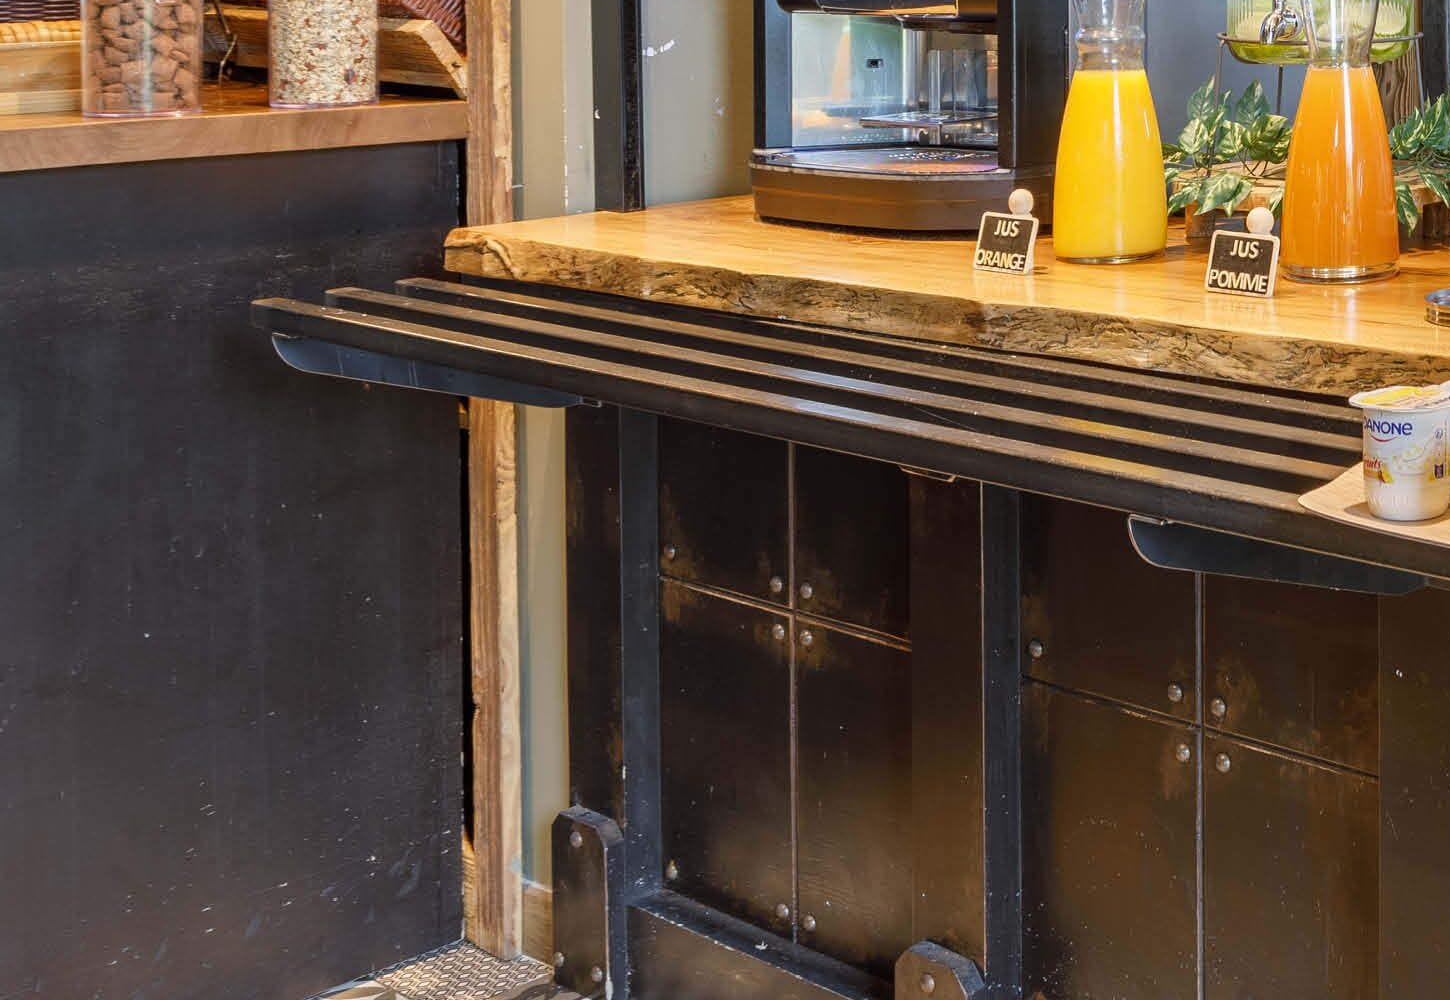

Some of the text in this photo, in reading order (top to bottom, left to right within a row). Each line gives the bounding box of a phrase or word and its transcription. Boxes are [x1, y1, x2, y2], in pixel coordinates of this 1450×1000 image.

[994, 219, 1020, 238] JUS
[976, 248, 1026, 270] ORANGE
[1229, 239, 1260, 259] JUS
[1208, 269, 1269, 293] POMME
